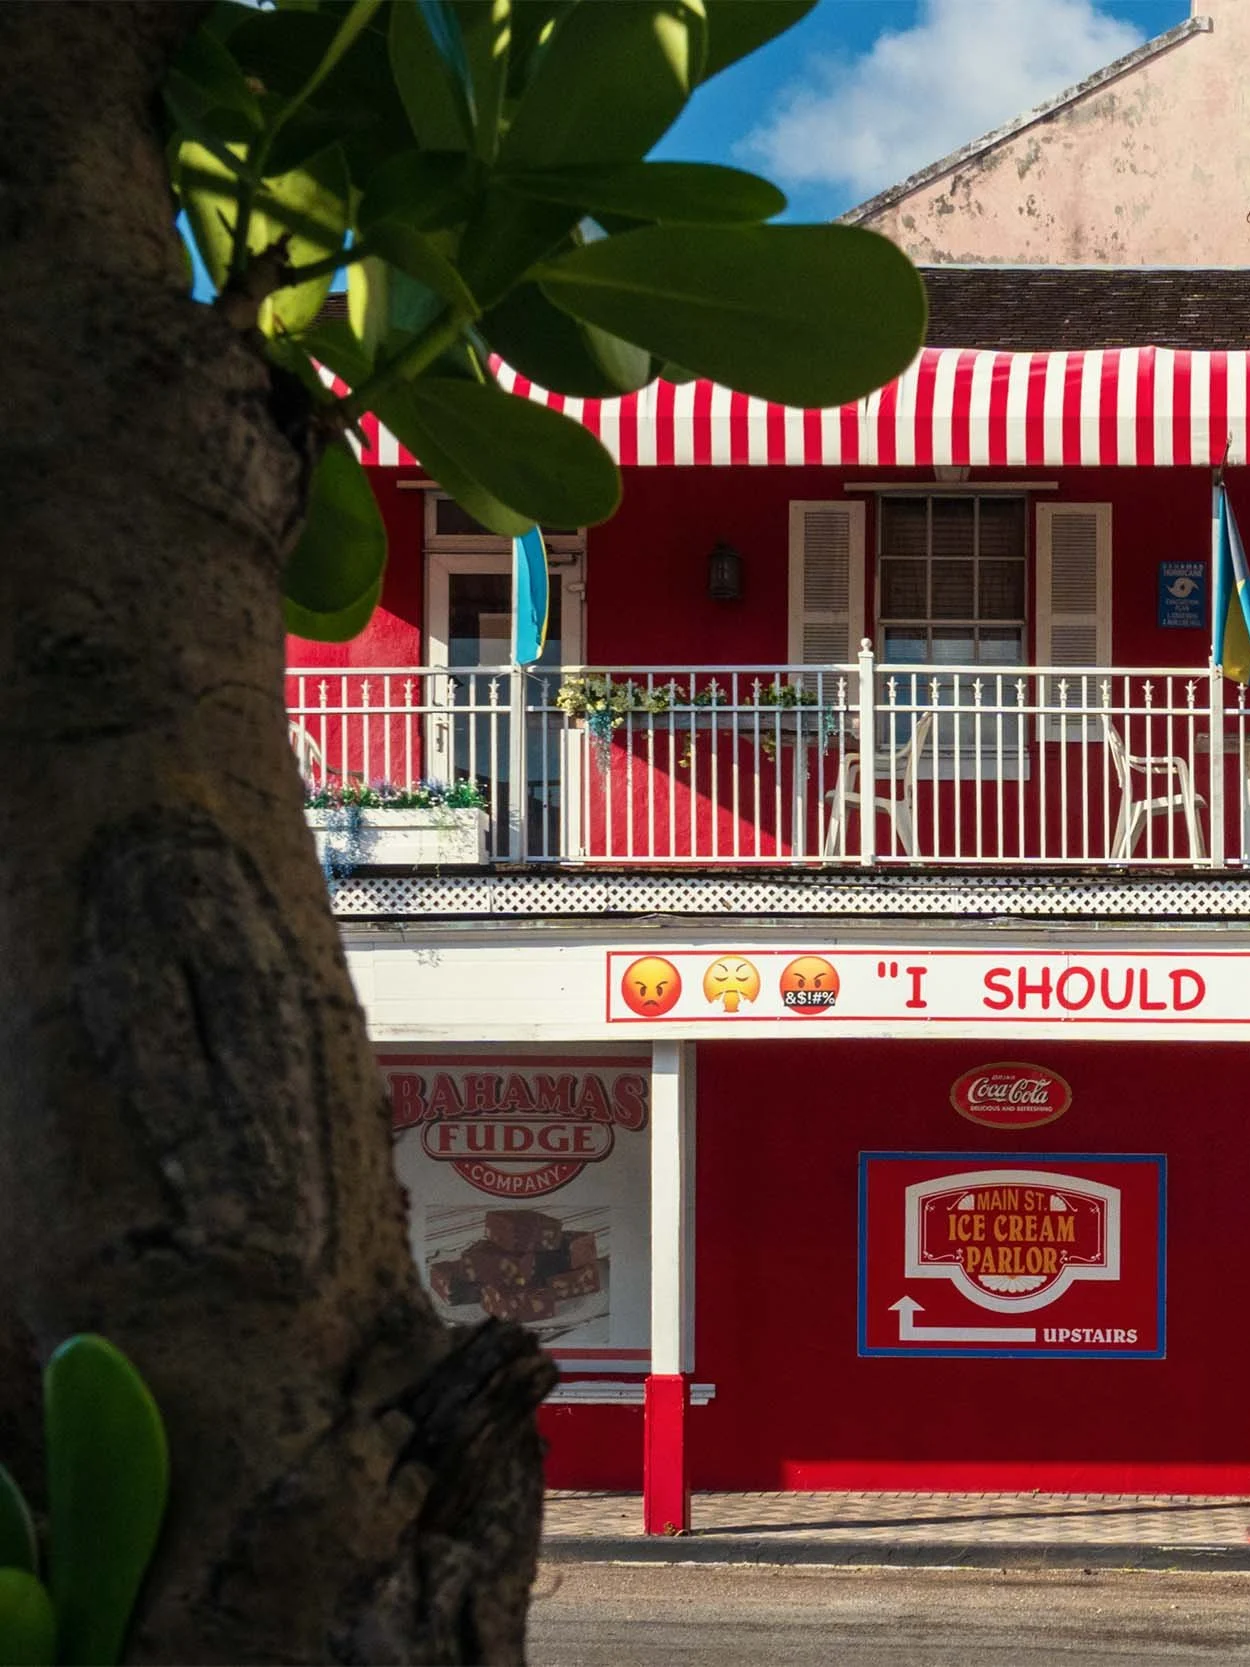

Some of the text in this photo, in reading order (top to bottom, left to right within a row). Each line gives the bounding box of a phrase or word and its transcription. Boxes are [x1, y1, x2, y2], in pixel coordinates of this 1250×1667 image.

[877, 961, 929, 1009] "I
[983, 966, 1207, 1012] SHOULD
[387, 1072, 649, 1131] BAHAMAS
[967, 1077, 1052, 1104] Coca-Cola
[438, 1125, 597, 1152] FUDGE
[470, 1162, 561, 1193] COMPANY
[976, 1189, 1048, 1212] MAIN ST.
[949, 1214, 1076, 1242] ICE CREAM
[965, 1246, 1059, 1275] PARLOR
[1043, 1328, 1138, 1343] UPSTAIRS
